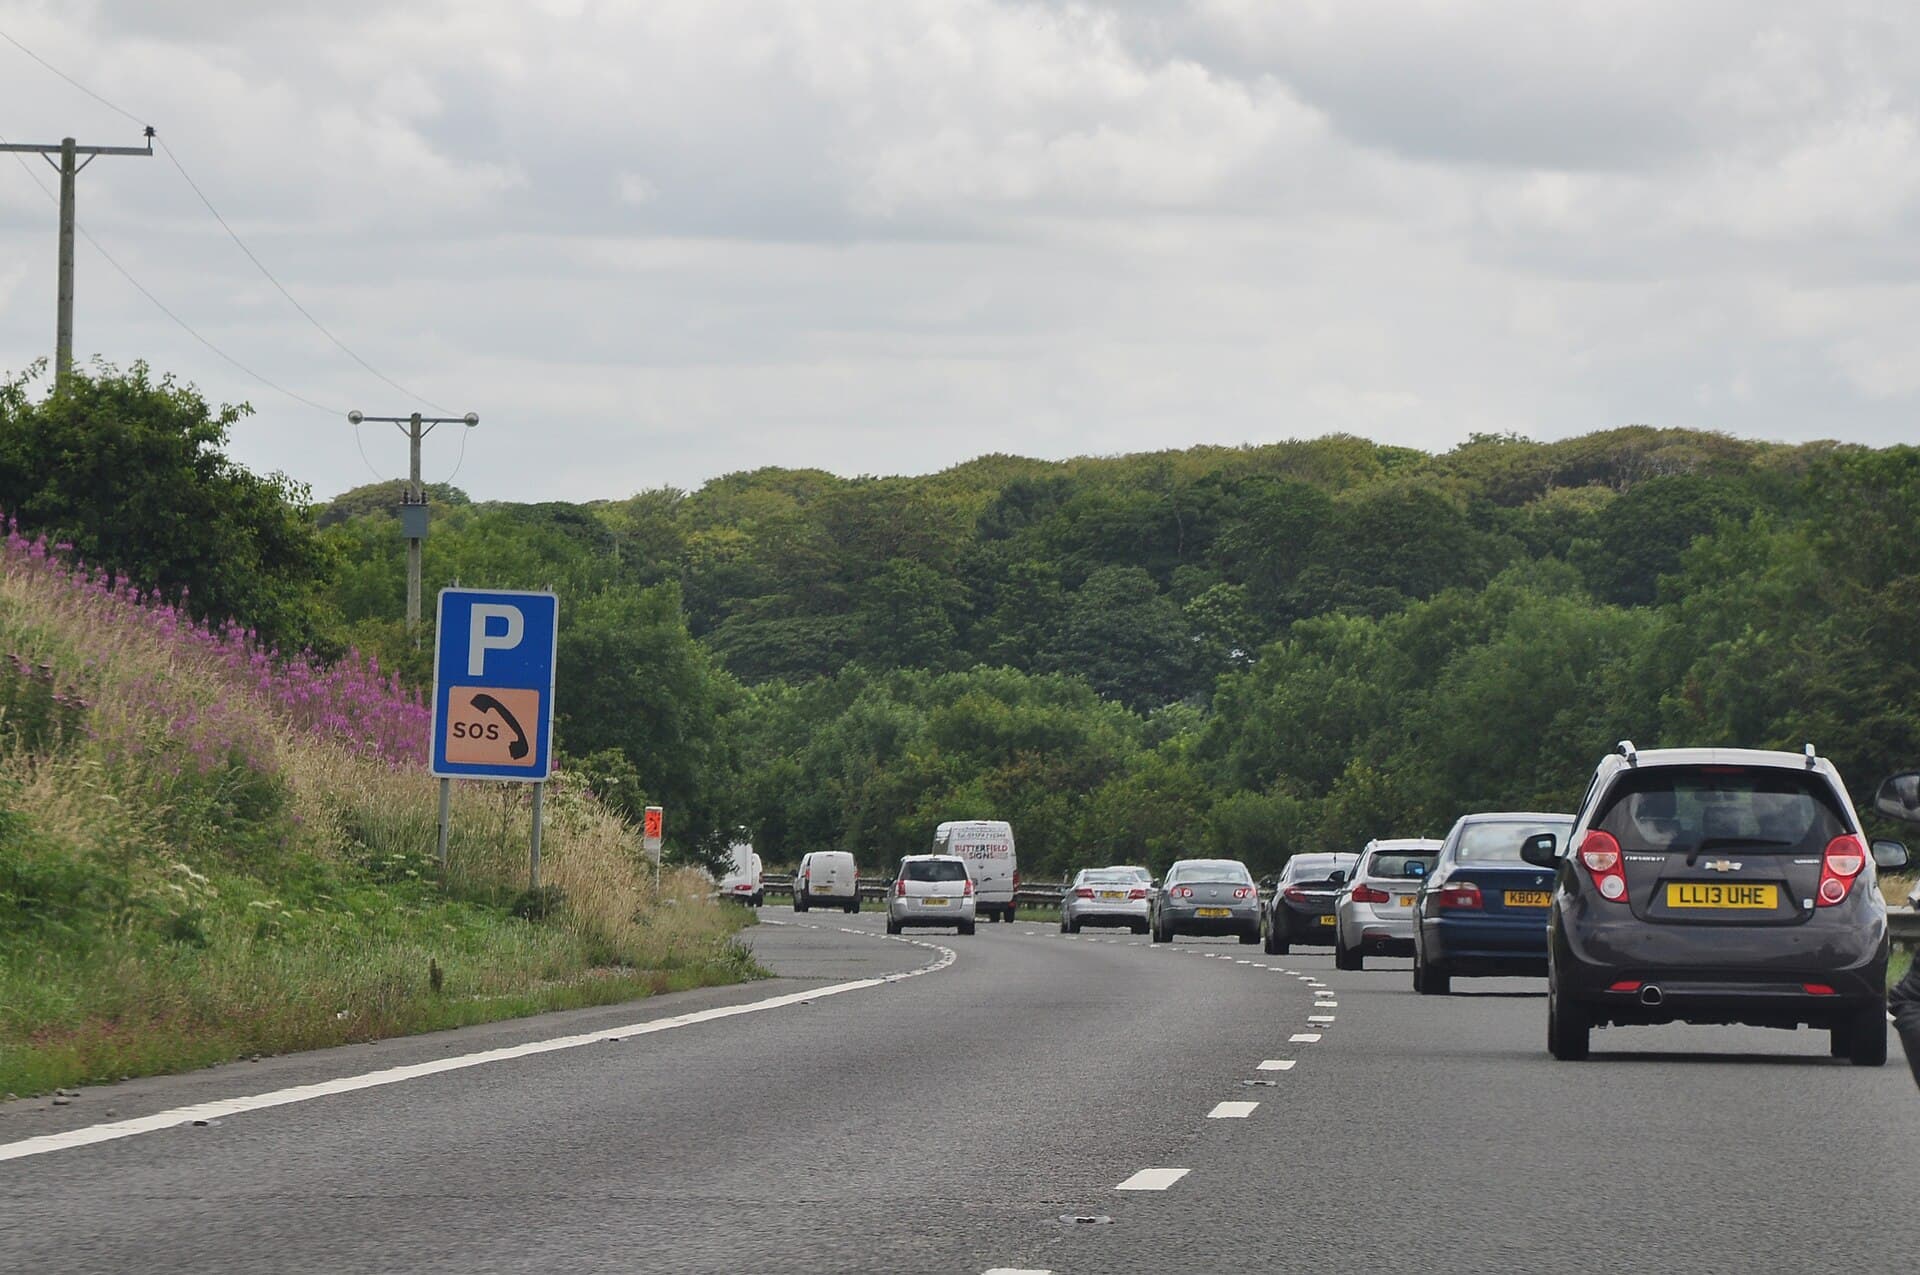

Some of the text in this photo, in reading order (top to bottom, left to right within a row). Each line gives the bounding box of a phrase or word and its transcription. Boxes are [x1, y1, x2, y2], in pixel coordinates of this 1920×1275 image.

[467, 603, 525, 677] P
[453, 721, 500, 741] SOS
[954, 844, 1009, 852] BUTTERFIELD
[1679, 886, 1765, 905] LL13 UHE
